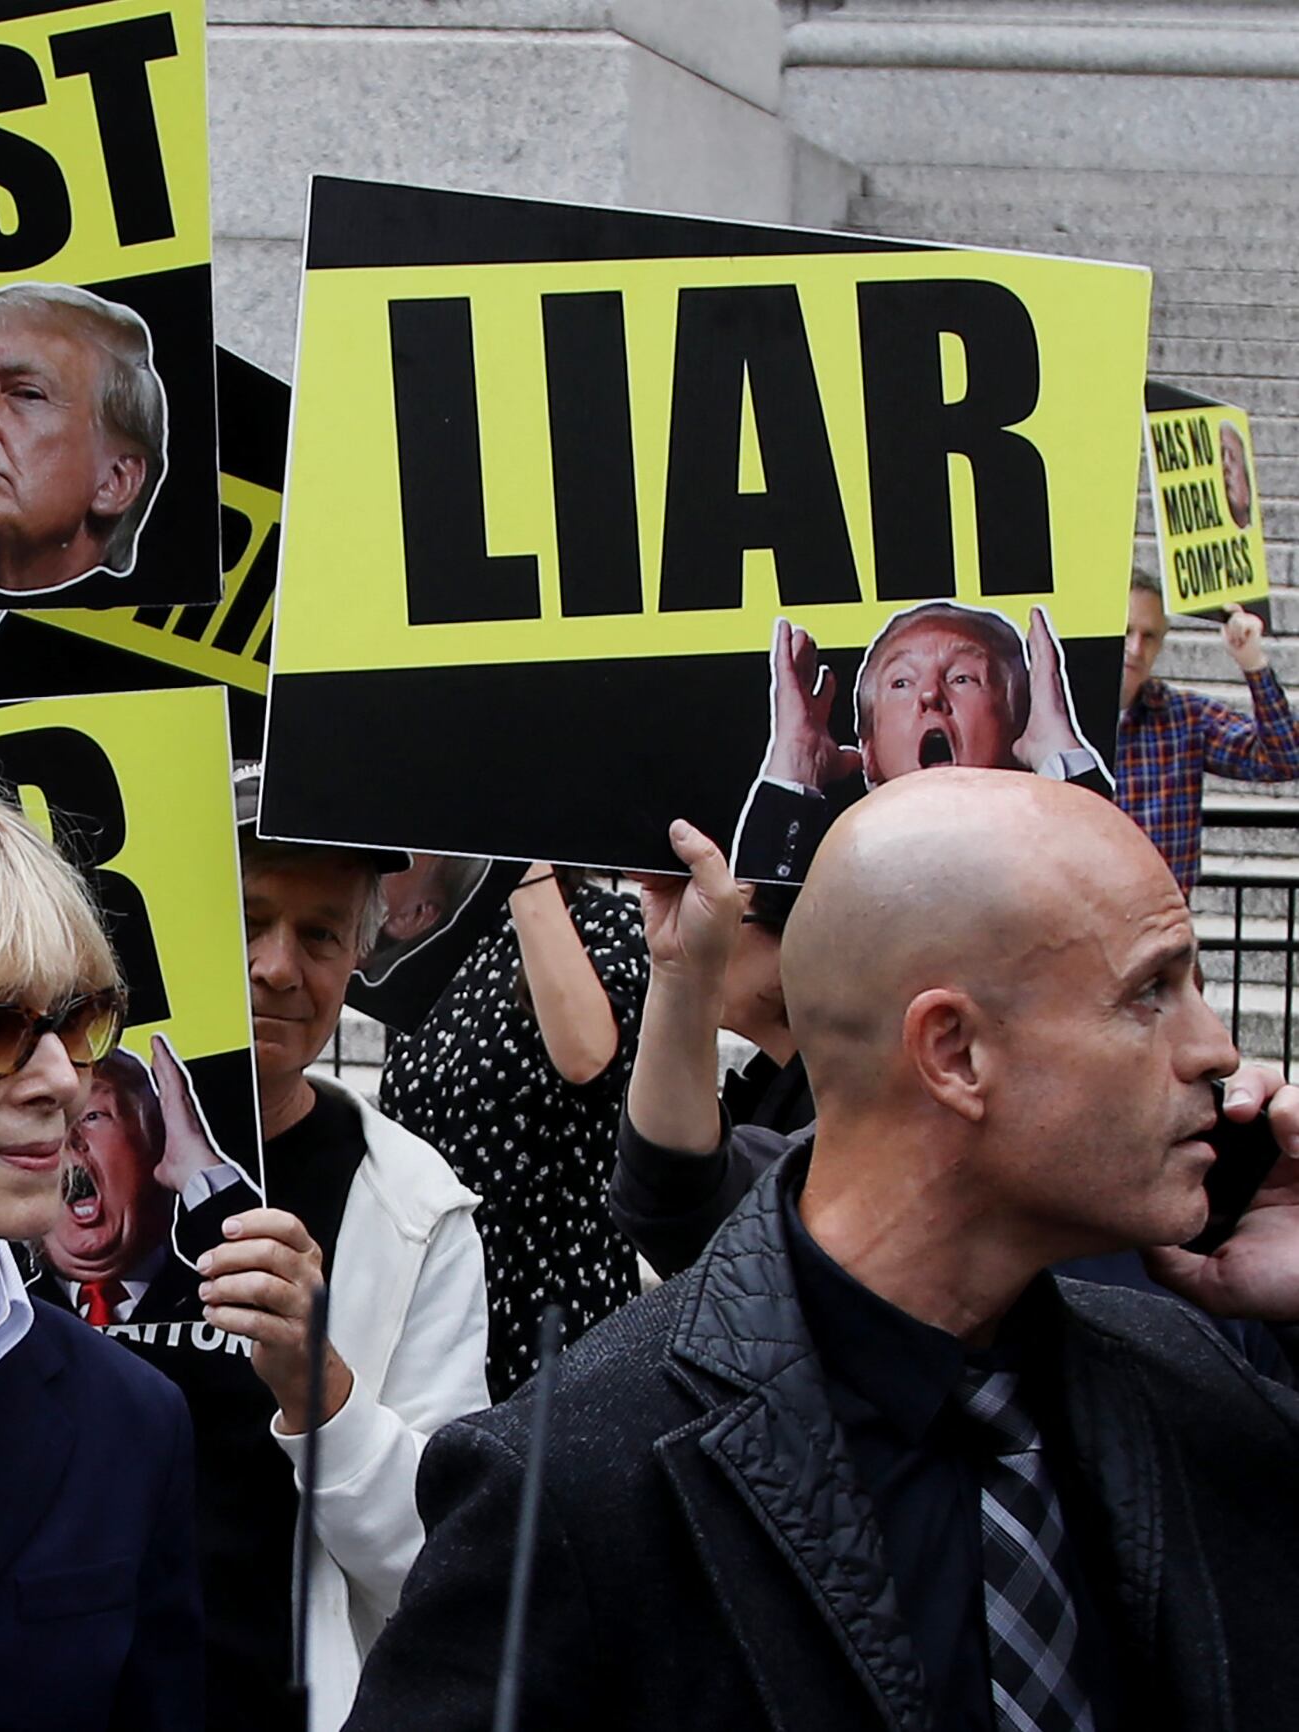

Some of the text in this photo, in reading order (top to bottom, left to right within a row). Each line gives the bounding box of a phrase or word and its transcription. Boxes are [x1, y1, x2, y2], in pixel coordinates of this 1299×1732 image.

[387, 278, 1054, 625] LIAR
[1151, 415, 1214, 473] HAS NO
[1162, 478, 1223, 536] MORAL
[1174, 534, 1254, 600] COMPASS
